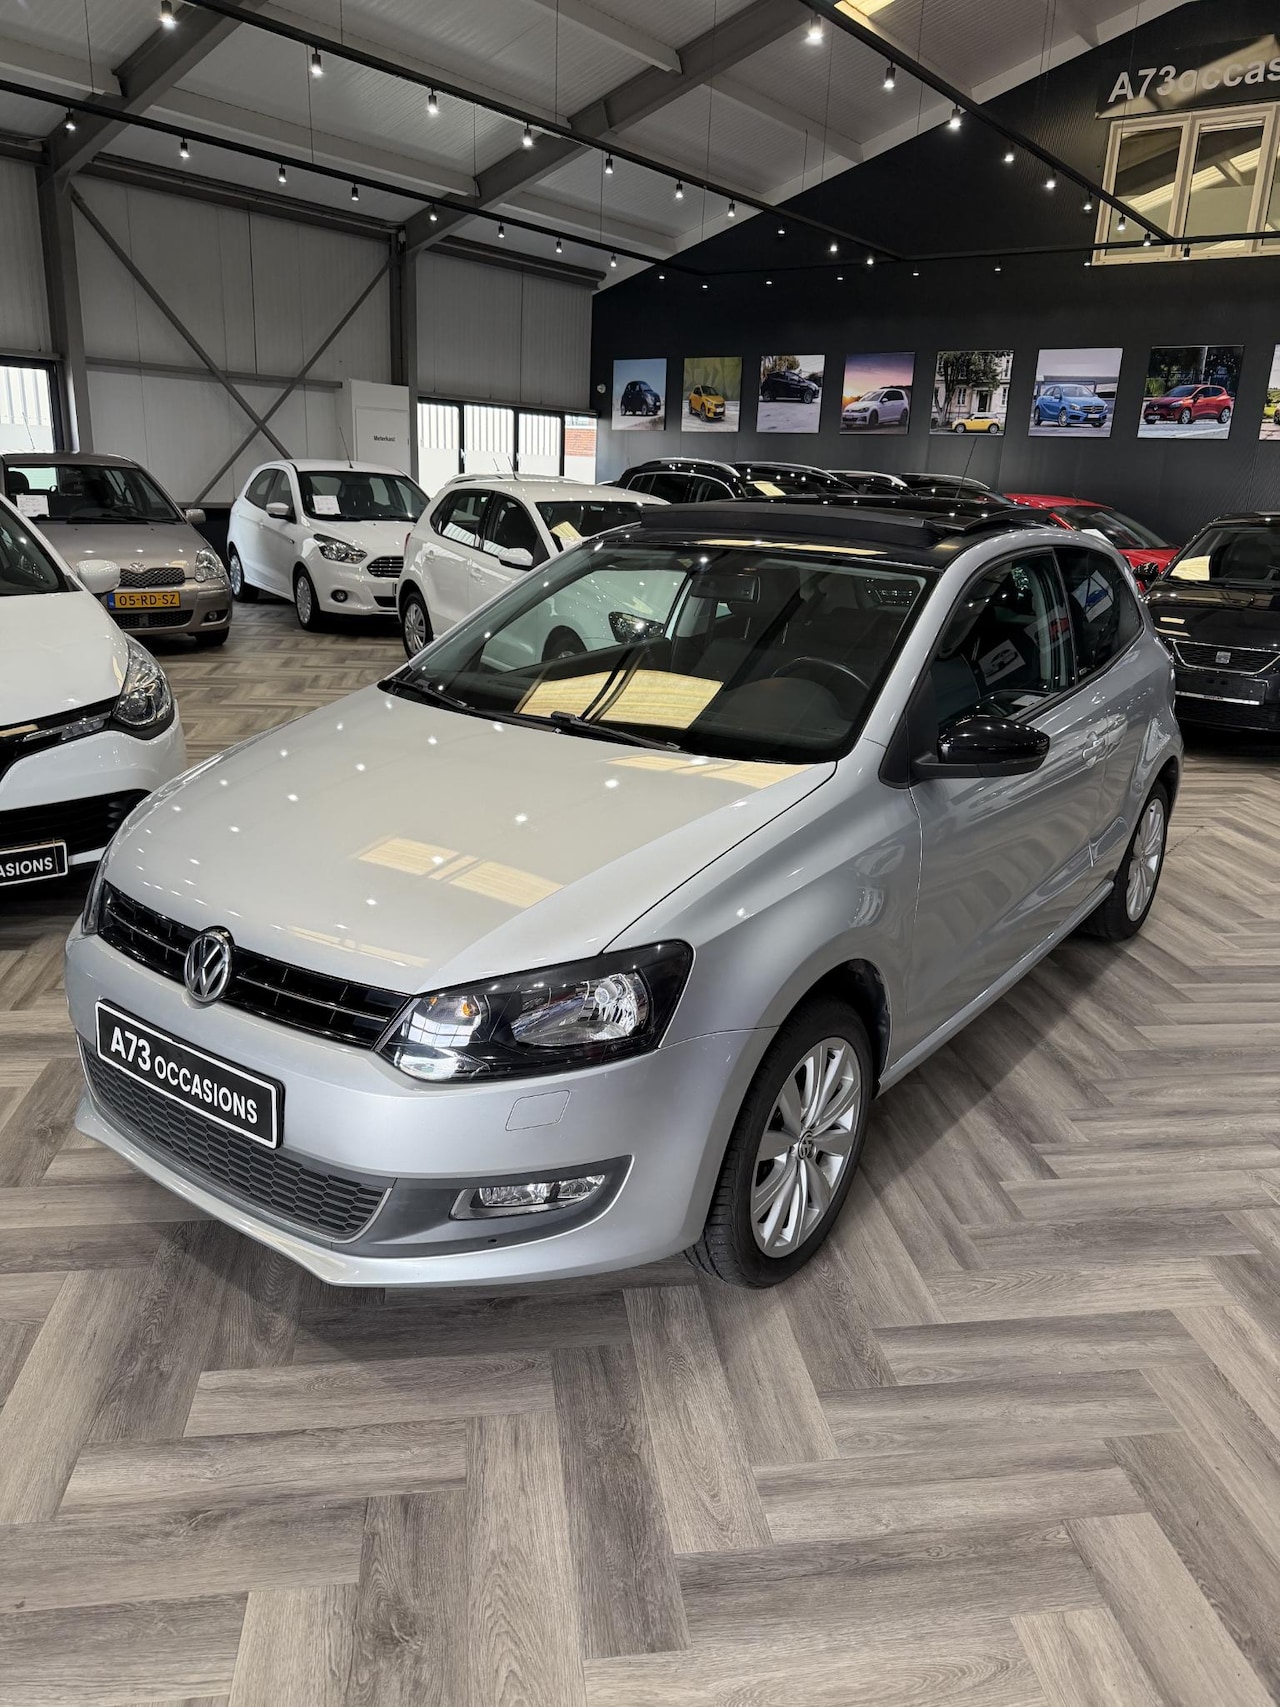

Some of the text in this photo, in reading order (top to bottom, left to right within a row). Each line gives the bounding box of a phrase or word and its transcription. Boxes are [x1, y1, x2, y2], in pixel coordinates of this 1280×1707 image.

[119, 594, 176, 606] 05-RD-SZ
[110, 1026, 258, 1124] A73 OCCASIONS
